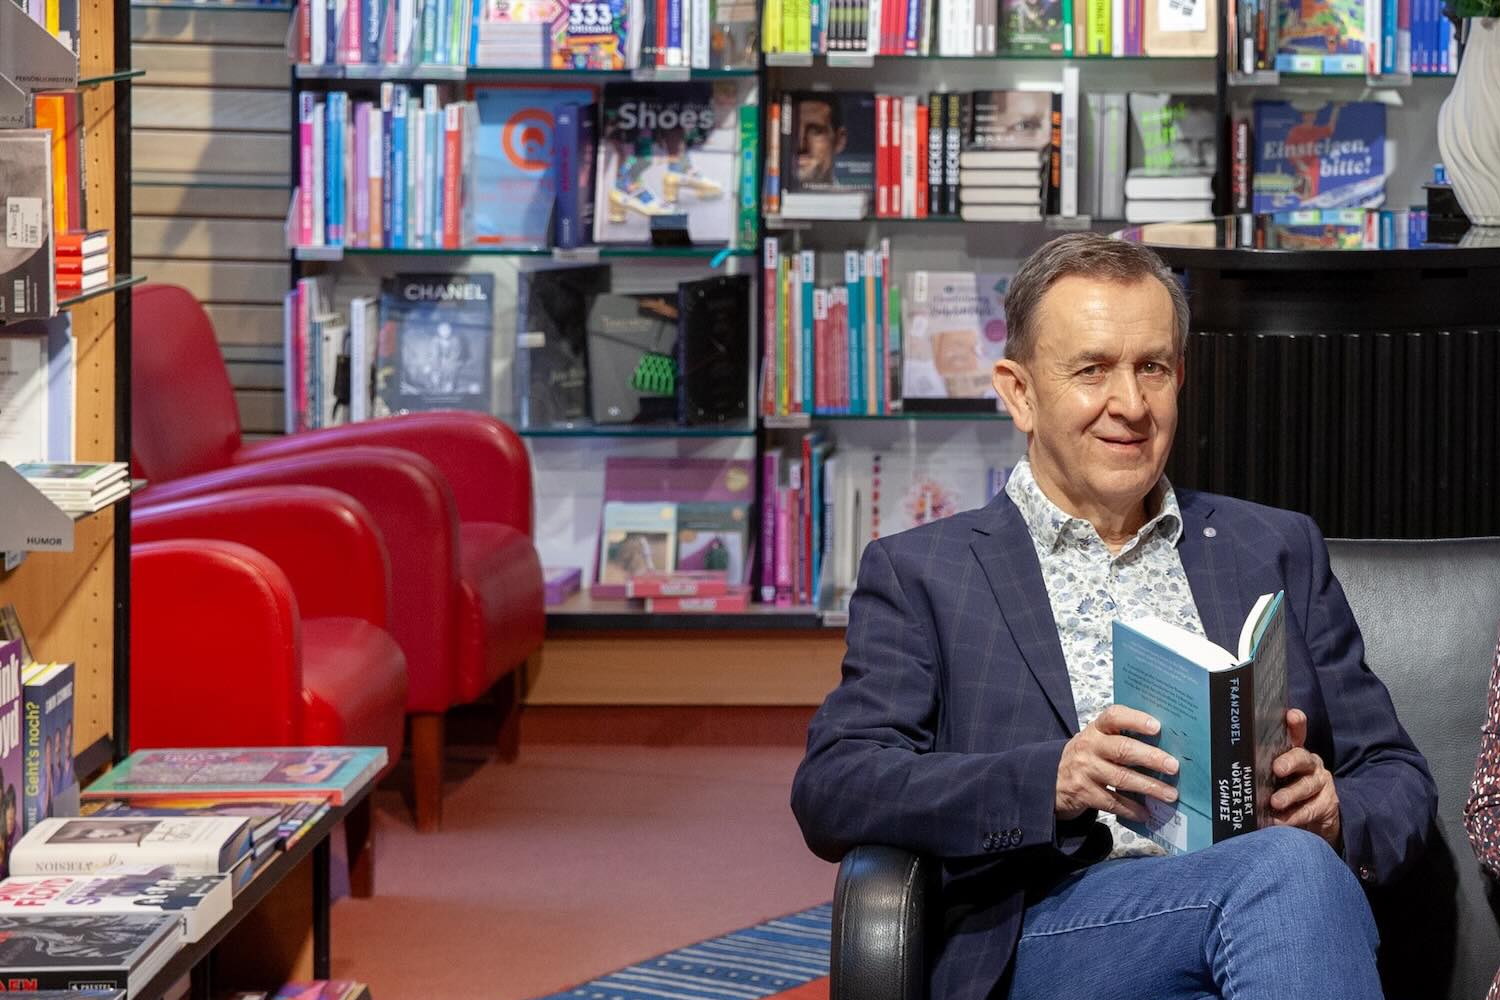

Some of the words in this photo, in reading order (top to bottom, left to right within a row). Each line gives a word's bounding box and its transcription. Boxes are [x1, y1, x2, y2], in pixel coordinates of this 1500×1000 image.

[567, 3, 614, 26] 333
[618, 102, 716, 130] Shoes
[929, 127, 942, 185] BECKER
[946, 127, 959, 185] BECKER
[1319, 155, 1373, 177] bitte!
[404, 283, 488, 301] CHANEL
[26, 536, 63, 546] HUMOR
[26, 701, 41, 746] noch?
[1229, 677, 1241, 745] FRANZOBEL
[25, 749, 40, 797] Geht's
[1231, 761, 1243, 807] WÖRTER
[1243, 766, 1254, 816] HUNDERT
[1218, 779, 1231, 822] SCHNEE
[1232, 808, 1243, 831] FÜR
